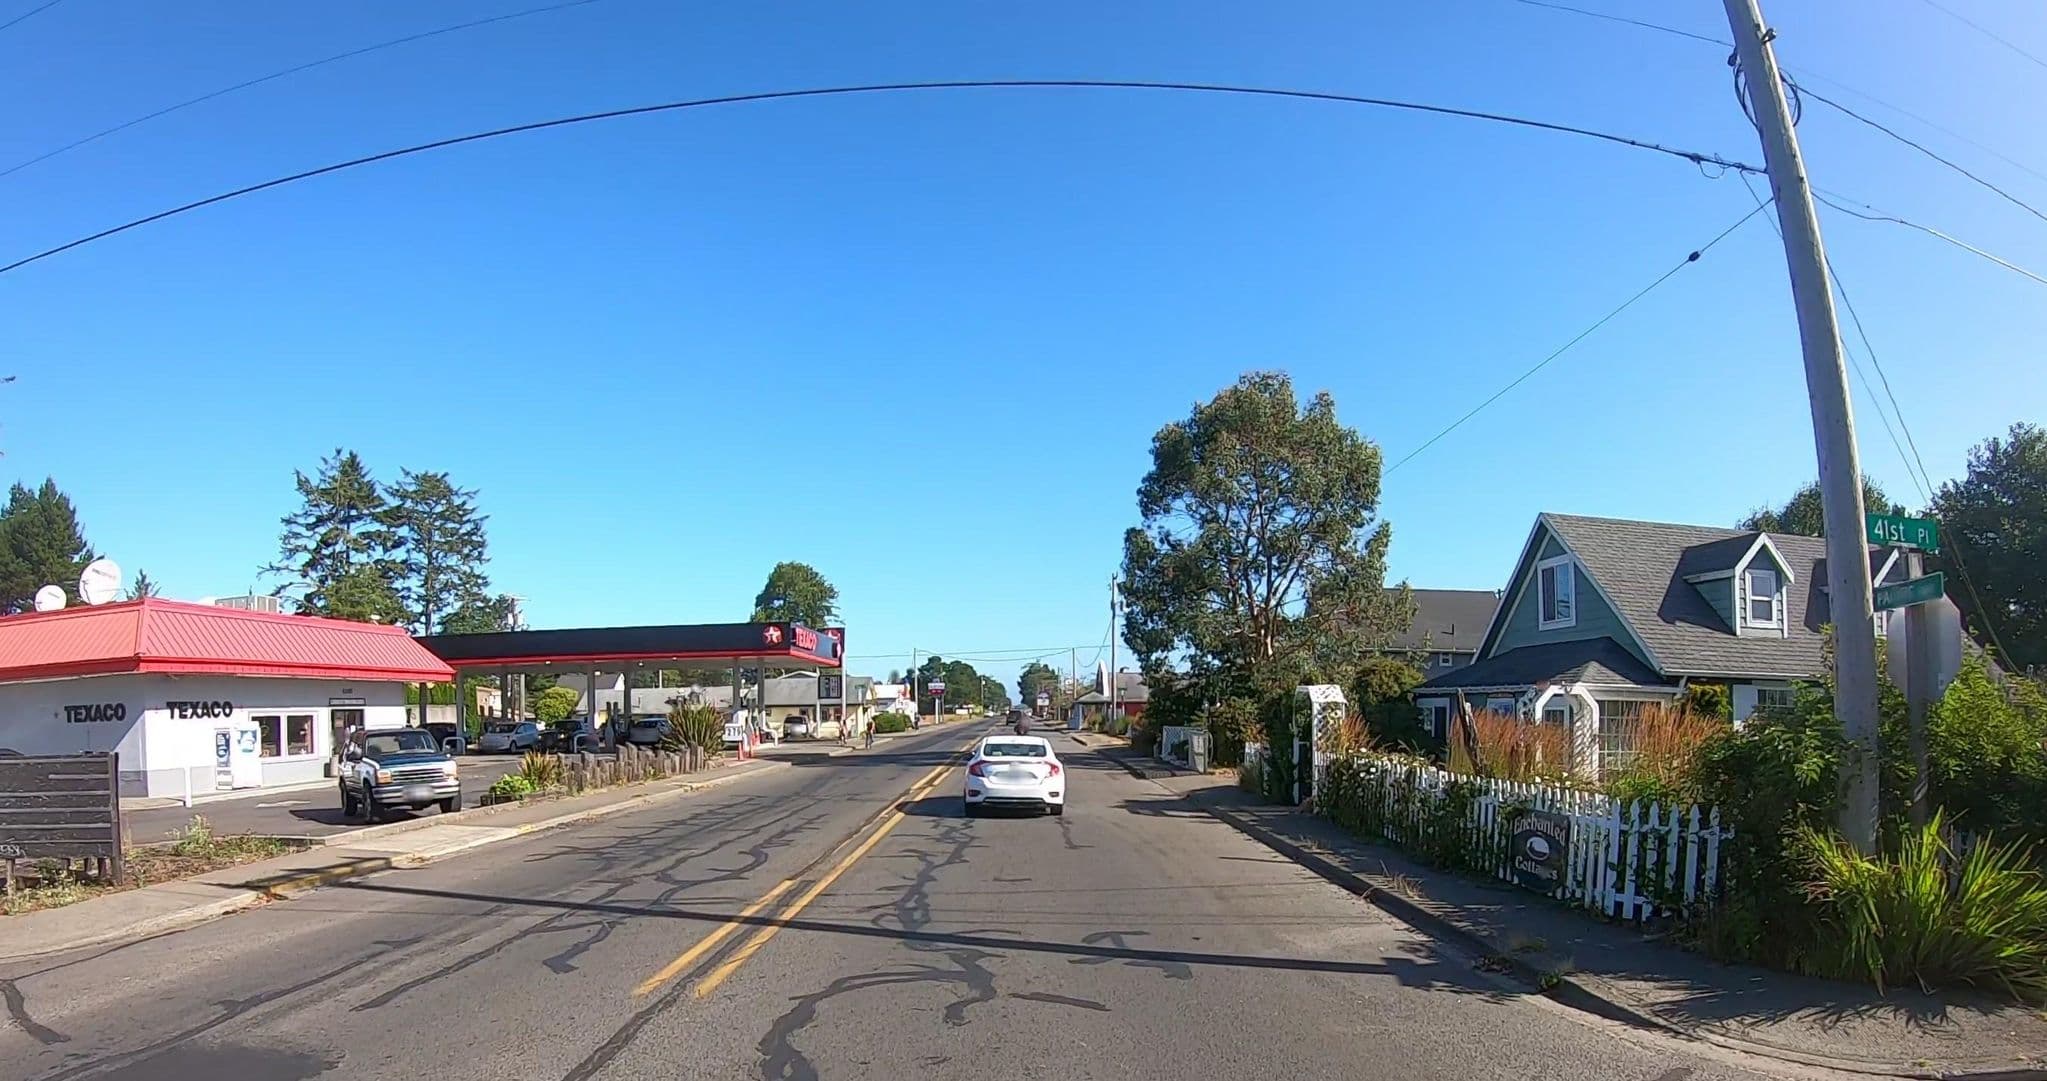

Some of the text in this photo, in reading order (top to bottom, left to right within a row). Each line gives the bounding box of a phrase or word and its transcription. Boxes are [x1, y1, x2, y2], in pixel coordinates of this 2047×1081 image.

[1874, 518, 1929, 544] 41st Pl
[795, 626, 817, 652] TEXACO
[64, 703, 127, 723] TEXACO
[166, 701, 233, 720] TEXACO
[1513, 812, 1567, 846] Enchanted
[1515, 855, 1559, 880] Cottas
